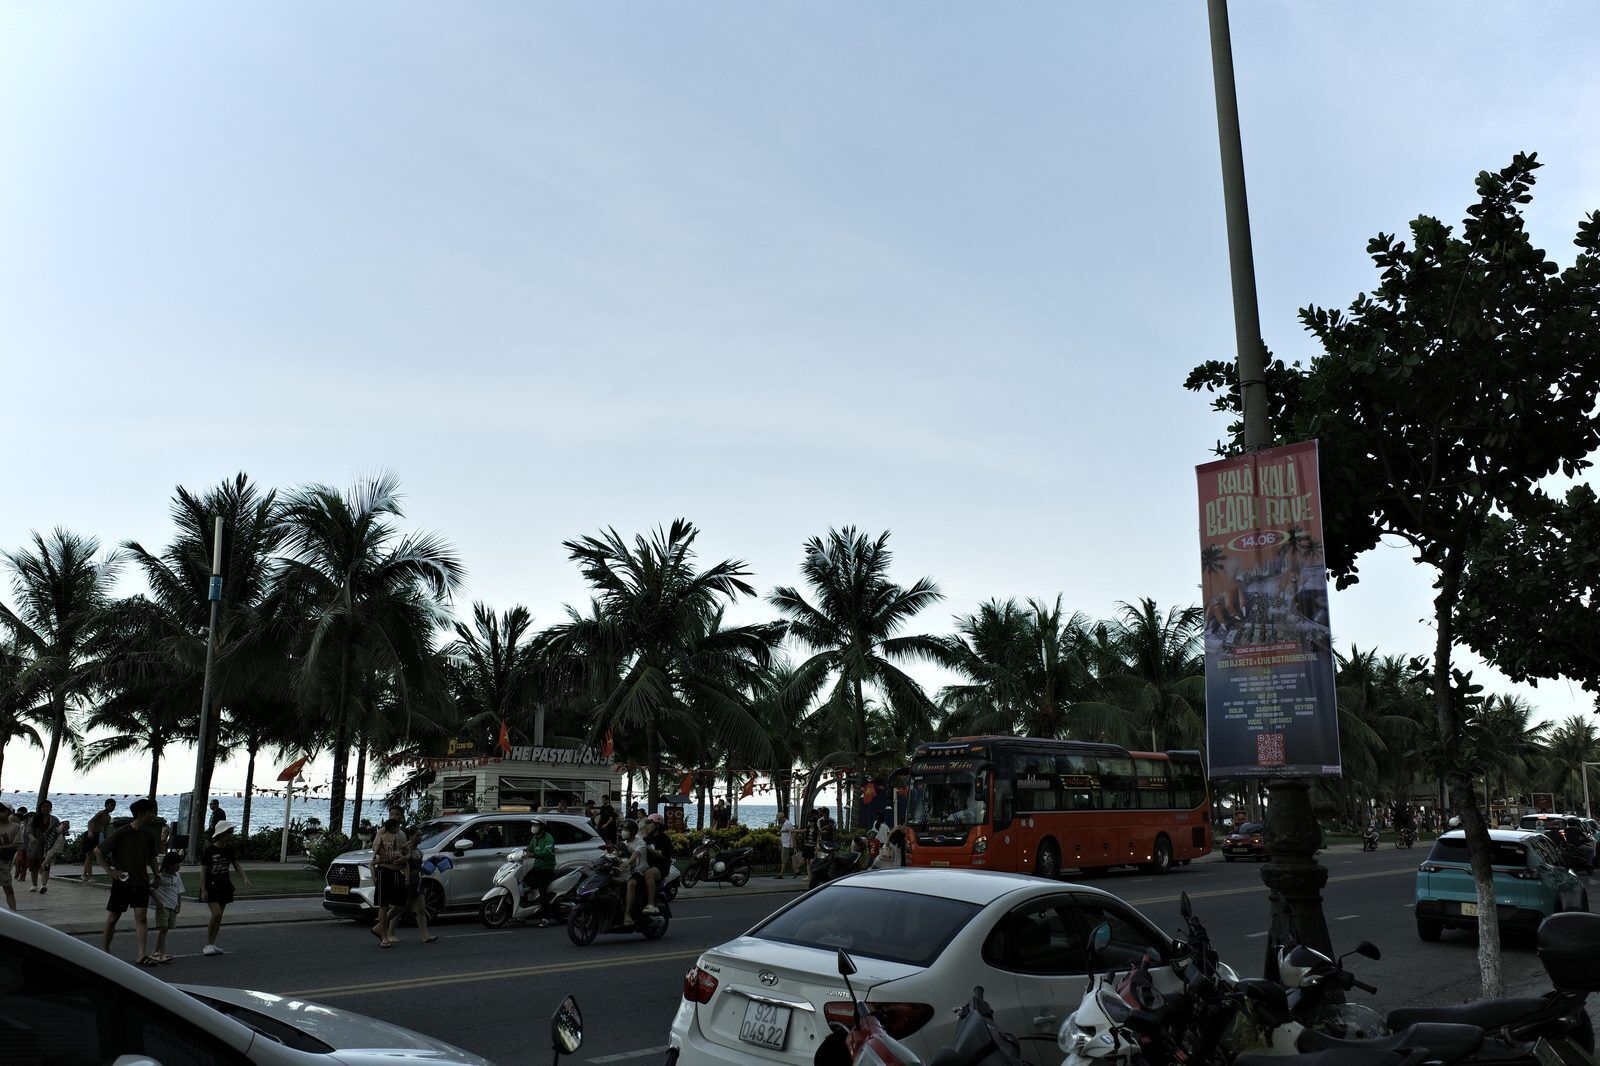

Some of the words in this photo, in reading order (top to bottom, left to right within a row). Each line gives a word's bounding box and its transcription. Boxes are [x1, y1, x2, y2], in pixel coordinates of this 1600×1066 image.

[1217, 463, 1254, 496] KALÀ
[1258, 455, 1298, 497] KALÀ
[1206, 495, 1261, 537] BEACH
[1266, 492, 1314, 526] RAVE
[1241, 533, 1276, 548] 14.06
[1238, 658, 1254, 667] SETS
[1258, 656, 1272, 666] LIVE
[1272, 653, 1318, 665] INSTRUMENTAL
[532, 746, 574, 763] PASTA
[826, 988, 851, 999] AVANTE
[755, 1002, 778, 1025] 92A
[742, 1021, 783, 1046] 049.22
